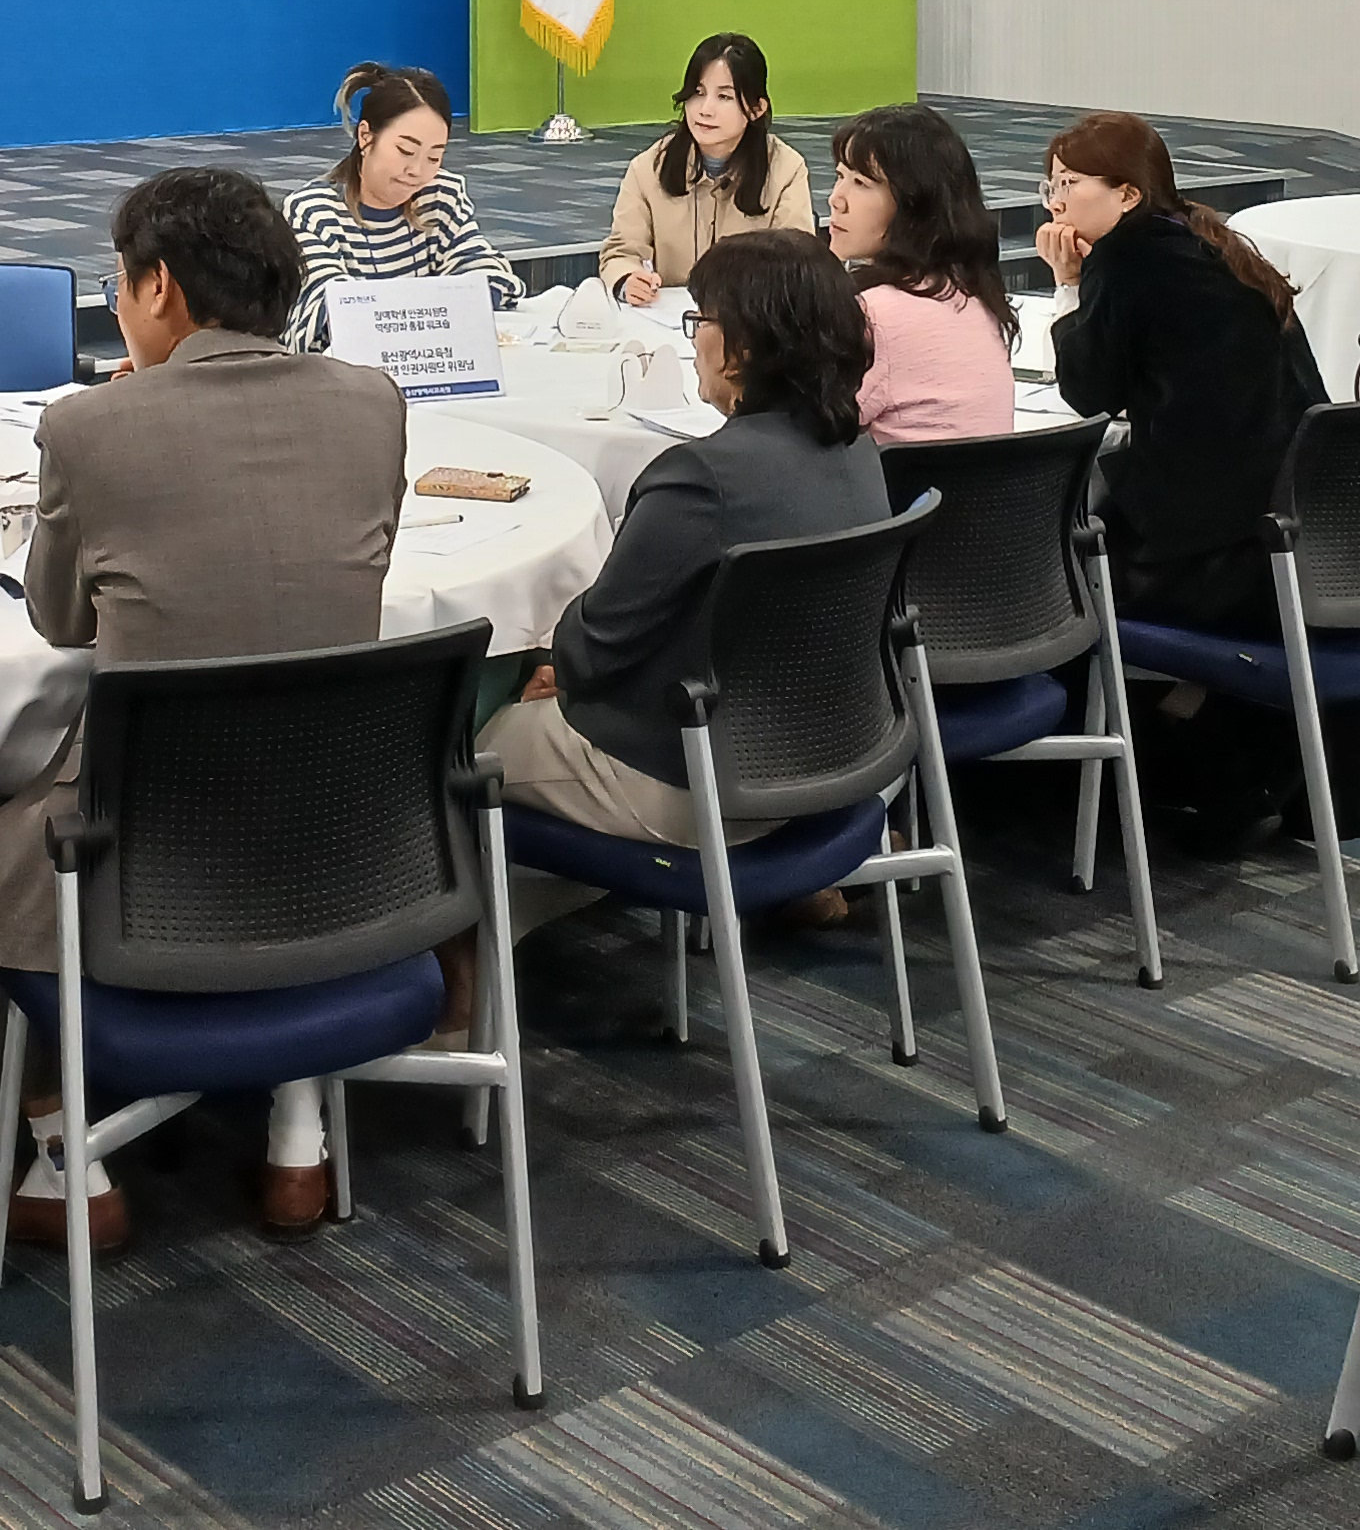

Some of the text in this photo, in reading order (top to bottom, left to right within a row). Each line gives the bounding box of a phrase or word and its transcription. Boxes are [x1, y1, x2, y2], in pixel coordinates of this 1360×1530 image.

[380, 347, 454, 364] 울산광역시교육청
[401, 360, 446, 376] 인권지원단
[448, 359, 475, 372] 위원님
